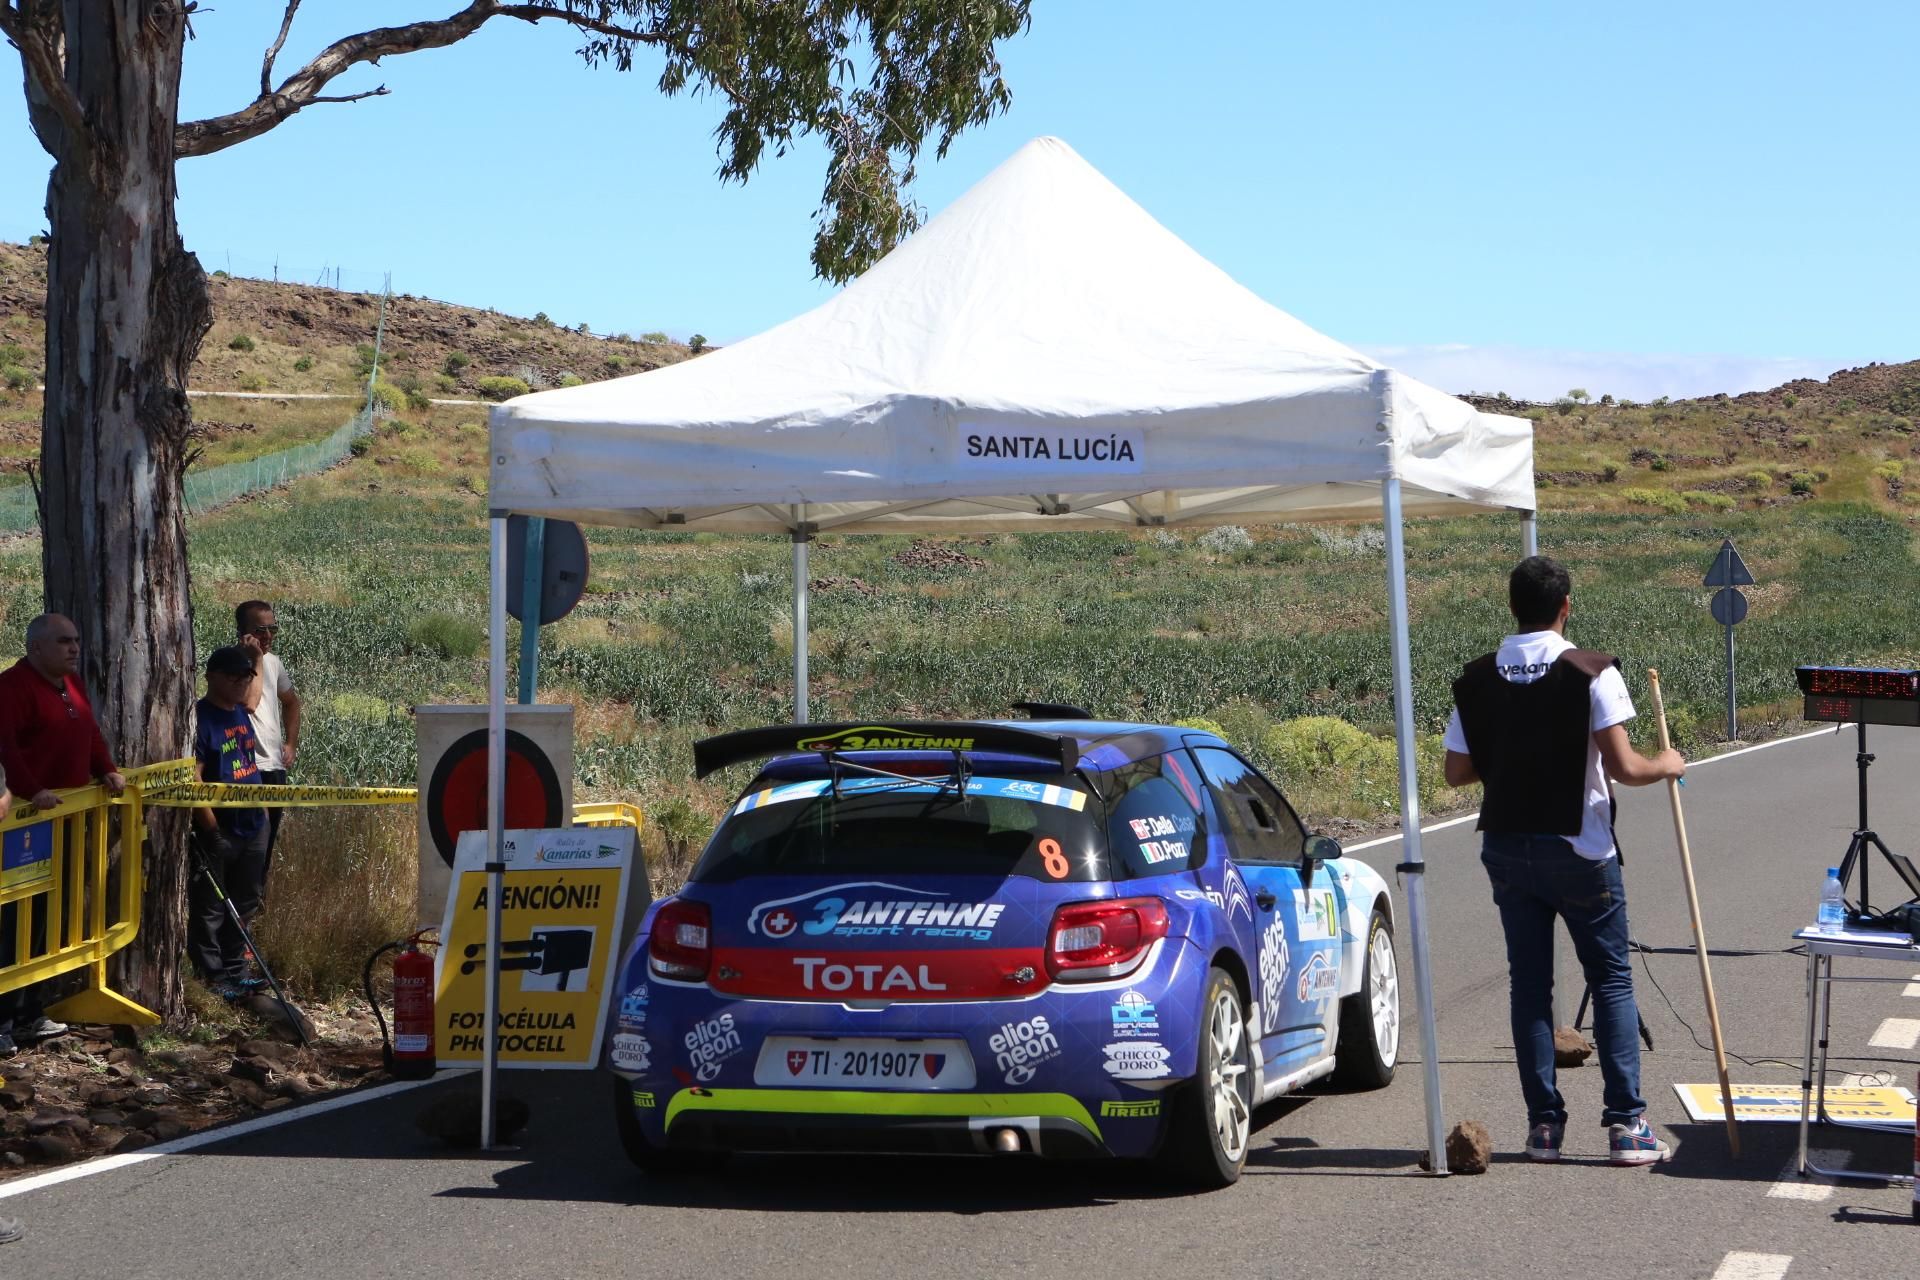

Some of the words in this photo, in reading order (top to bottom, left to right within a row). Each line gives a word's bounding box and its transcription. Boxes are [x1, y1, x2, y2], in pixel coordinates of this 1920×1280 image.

[967, 435, 1051, 459] SANTA
[1058, 433, 1135, 462] LUCÍA
[1038, 838, 1069, 879] 8
[473, 877, 601, 910] AENCIÓN!!
[833, 924, 904, 937] sport
[911, 926, 993, 941] racing
[1260, 910, 1284, 980] elios
[793, 957, 947, 992] TOTAL
[1263, 938, 1290, 1013] neon
[448, 1007, 576, 1030] FOTCÉLULA
[684, 1013, 735, 1050] elios
[989, 1015, 1050, 1053] elios
[689, 1029, 741, 1068] neon
[841, 1052, 921, 1078] 201907
[996, 1032, 1059, 1072] neon
[1113, 1050, 1162, 1061] CHICCO
[1119, 1060, 1159, 1071] D'ORO
[1100, 1100, 1161, 1117] PIRELLI
